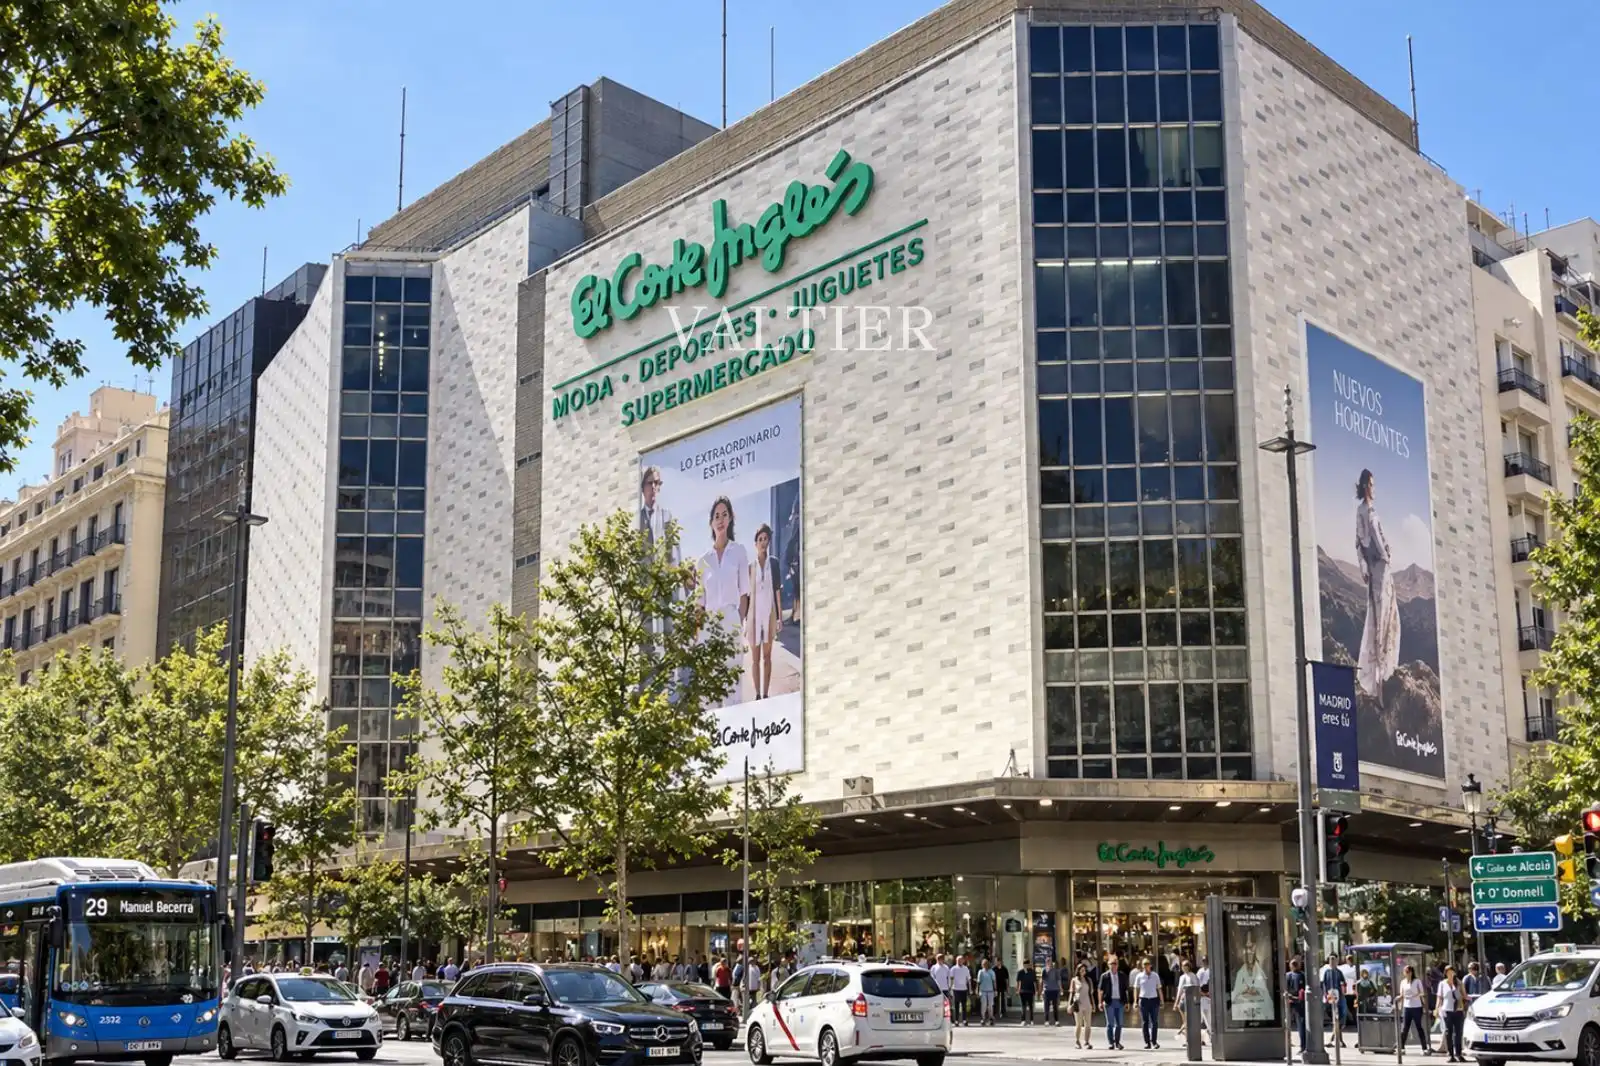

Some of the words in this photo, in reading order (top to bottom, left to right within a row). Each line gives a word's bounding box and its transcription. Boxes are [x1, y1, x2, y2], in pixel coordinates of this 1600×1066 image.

[571, 275, 612, 338] El
[611, 238, 705, 320] Corte
[707, 148, 875, 298] Inglés
[552, 374, 613, 420] MODA
[640, 311, 758, 383] DEPORTES
[788, 237, 925, 318] JUGUETES
[621, 327, 816, 426] SUPERMERCADO
[1333, 368, 1383, 416] NUEVOS
[680, 458, 693, 472] LO
[695, 425, 781, 466] EXTRAORDINARIO
[1334, 400, 1410, 459] HORIZONTES
[703, 460, 727, 480] ESTÁ
[730, 455, 743, 471] EN
[745, 450, 756, 464] TI
[1319, 693, 1351, 710] MADRID
[1322, 713, 1340, 726] eres
[1341, 714, 1350, 727] tú
[722, 726, 750, 746] Corte
[751, 717, 791, 749] Inglés
[1097, 842, 1116, 862] El
[1116, 843, 1155, 862] Corte
[85, 898, 108, 917] 29
[120, 900, 154, 913] Manuel
[157, 901, 194, 914] Becerra
